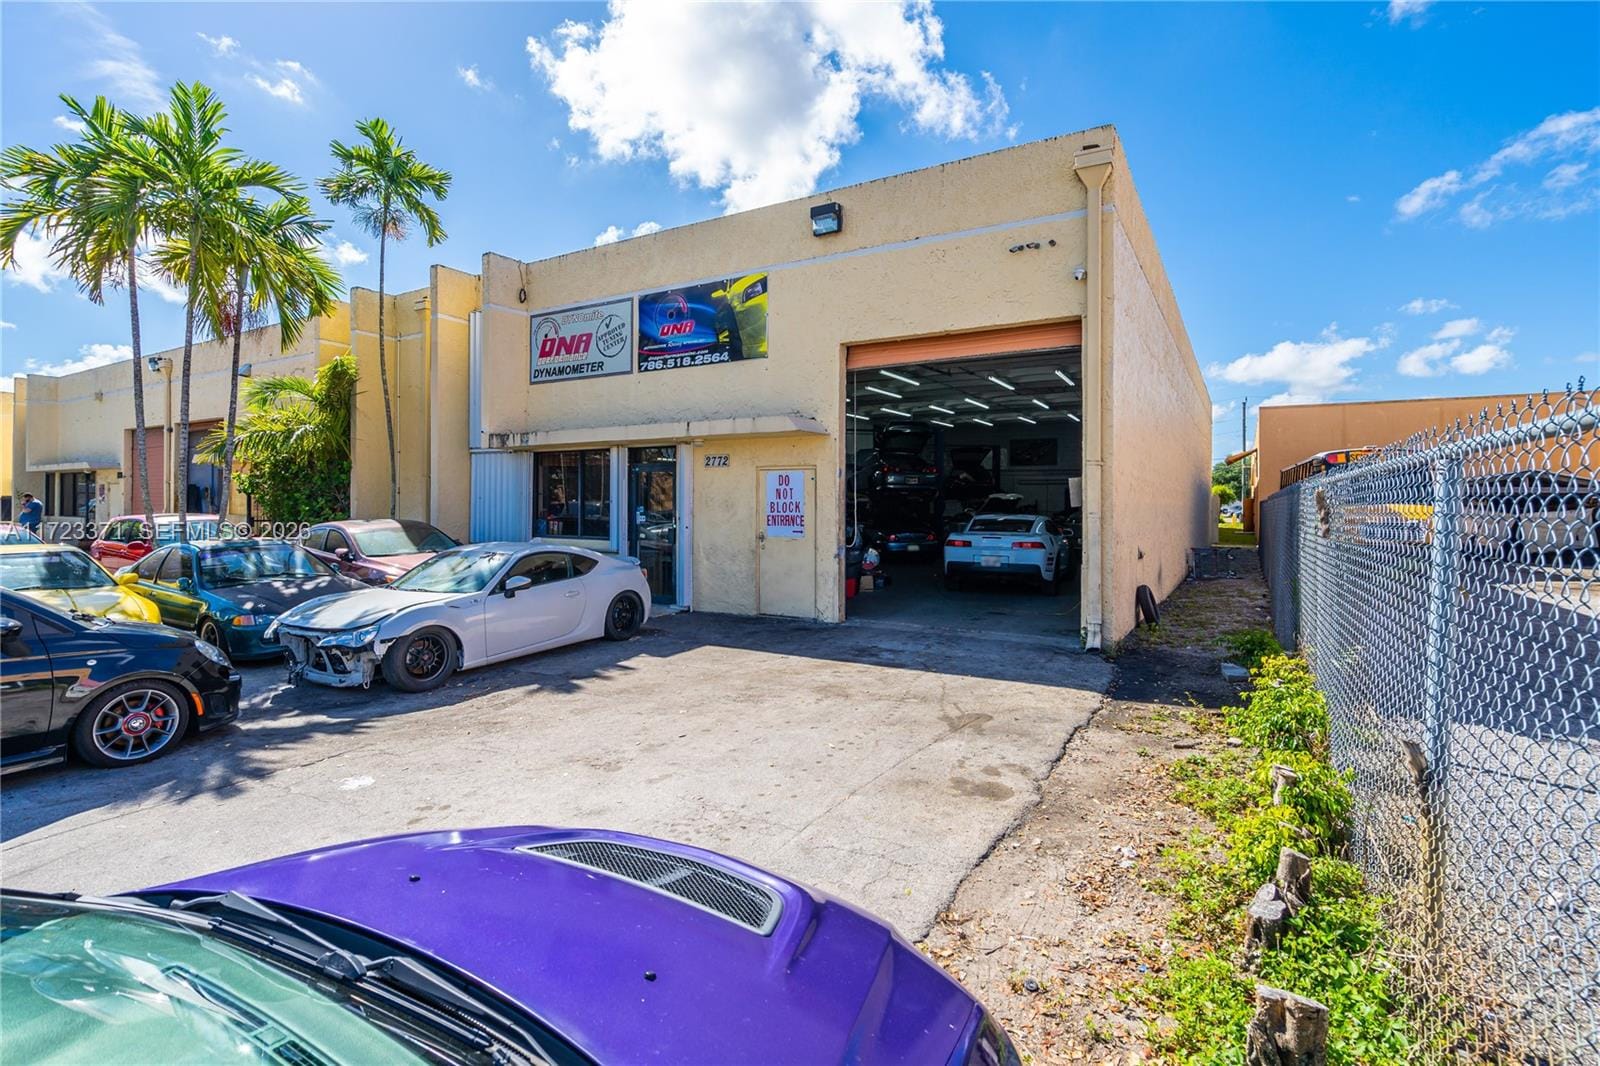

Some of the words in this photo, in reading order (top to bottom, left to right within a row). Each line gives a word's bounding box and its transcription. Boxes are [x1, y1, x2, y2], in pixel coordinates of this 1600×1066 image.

[598, 322, 626, 341] APPROVED
[659, 319, 695, 337] DNA
[538, 332, 593, 359] DNA
[602, 330, 623, 346] TUNING
[603, 337, 625, 352] CENTER
[640, 351, 729, 371] 786.518.2564
[533, 361, 604, 379] DYNAMOMETER
[705, 456, 729, 467] 2772
[778, 474, 790, 486] DO
[775, 488, 794, 500] NOT
[769, 501, 801, 514] BLOCK
[766, 515, 805, 527] ENTRANCE
